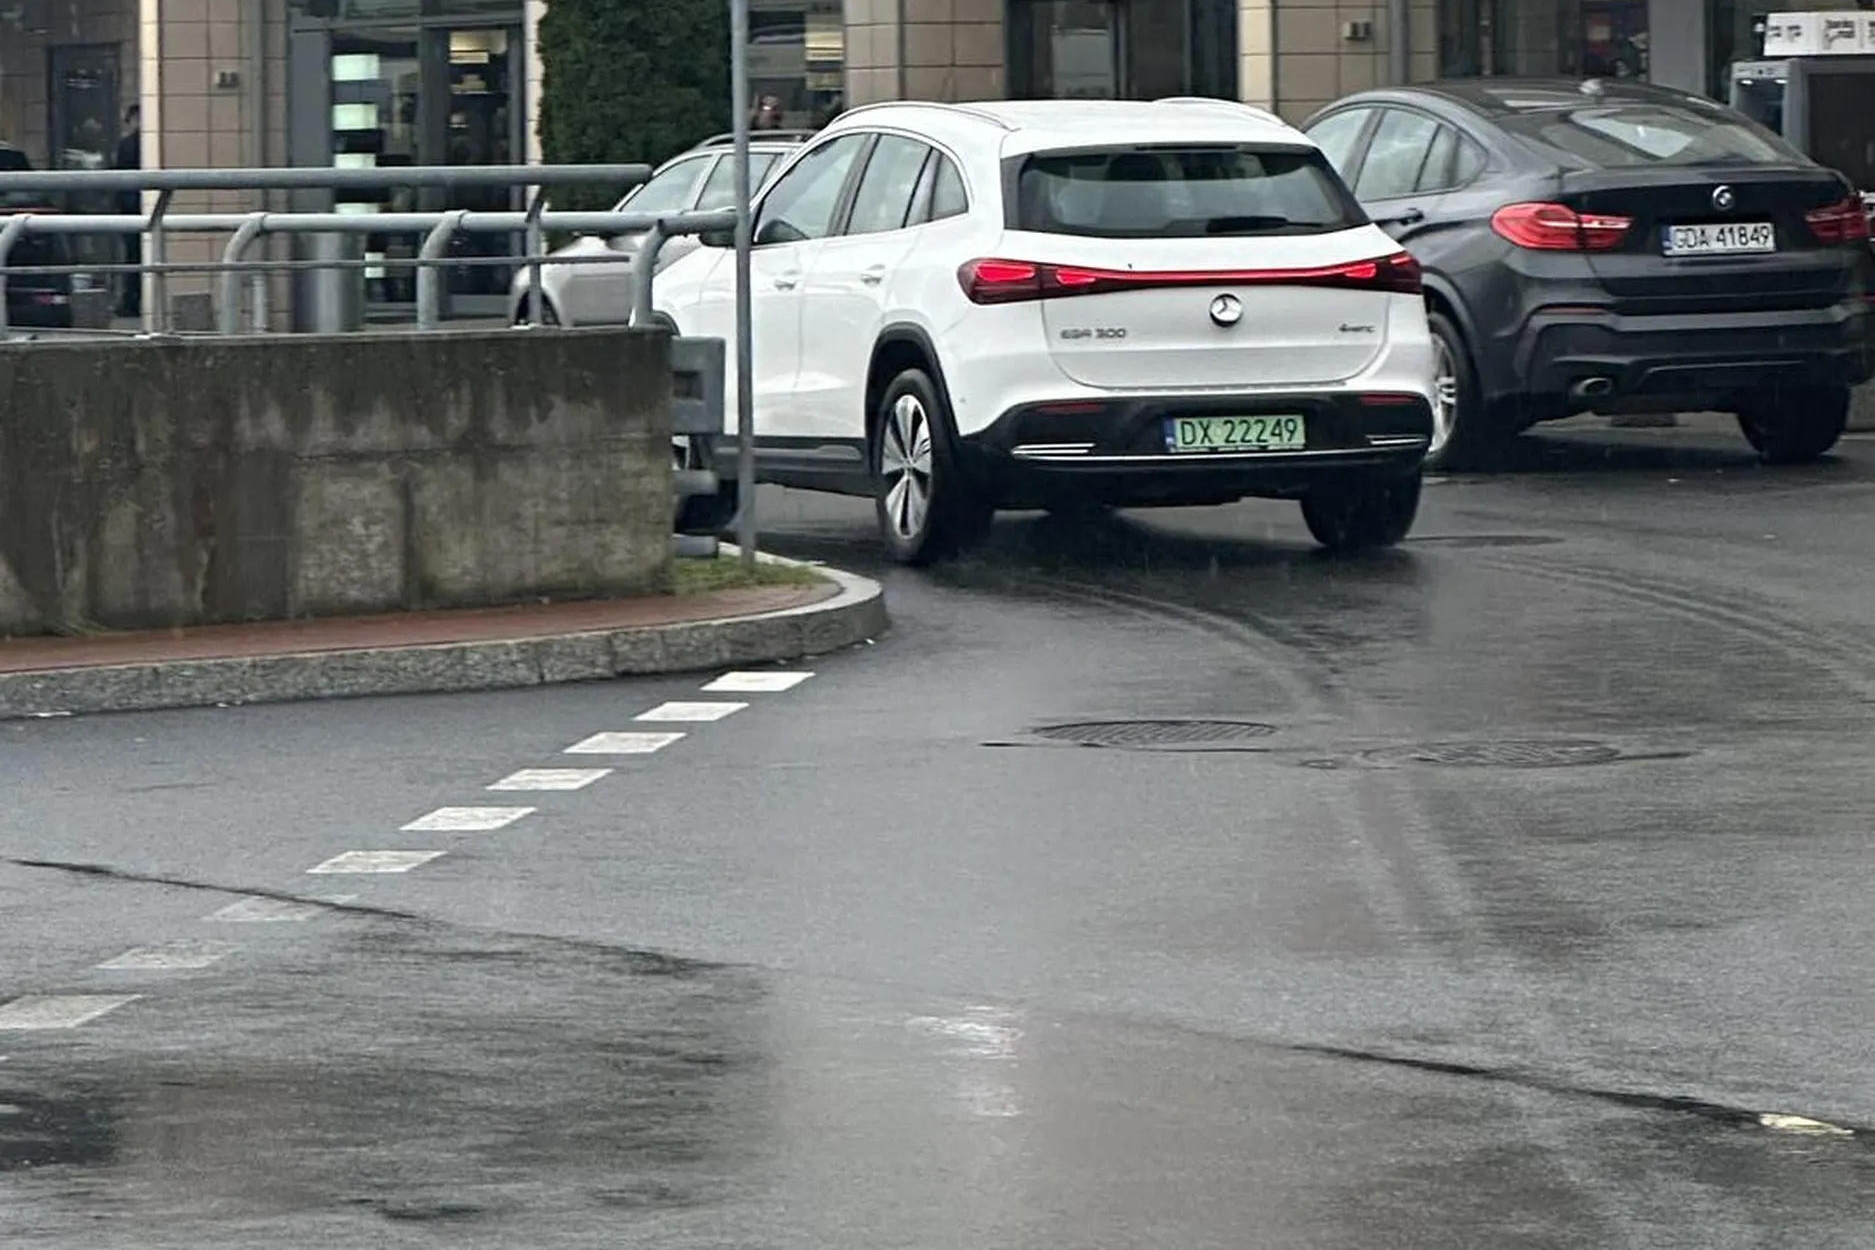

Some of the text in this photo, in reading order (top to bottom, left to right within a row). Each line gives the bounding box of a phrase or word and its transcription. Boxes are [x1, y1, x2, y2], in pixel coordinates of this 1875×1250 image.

[1715, 225, 1770, 247] 41849
[1180, 418, 1298, 446] DX 22249
